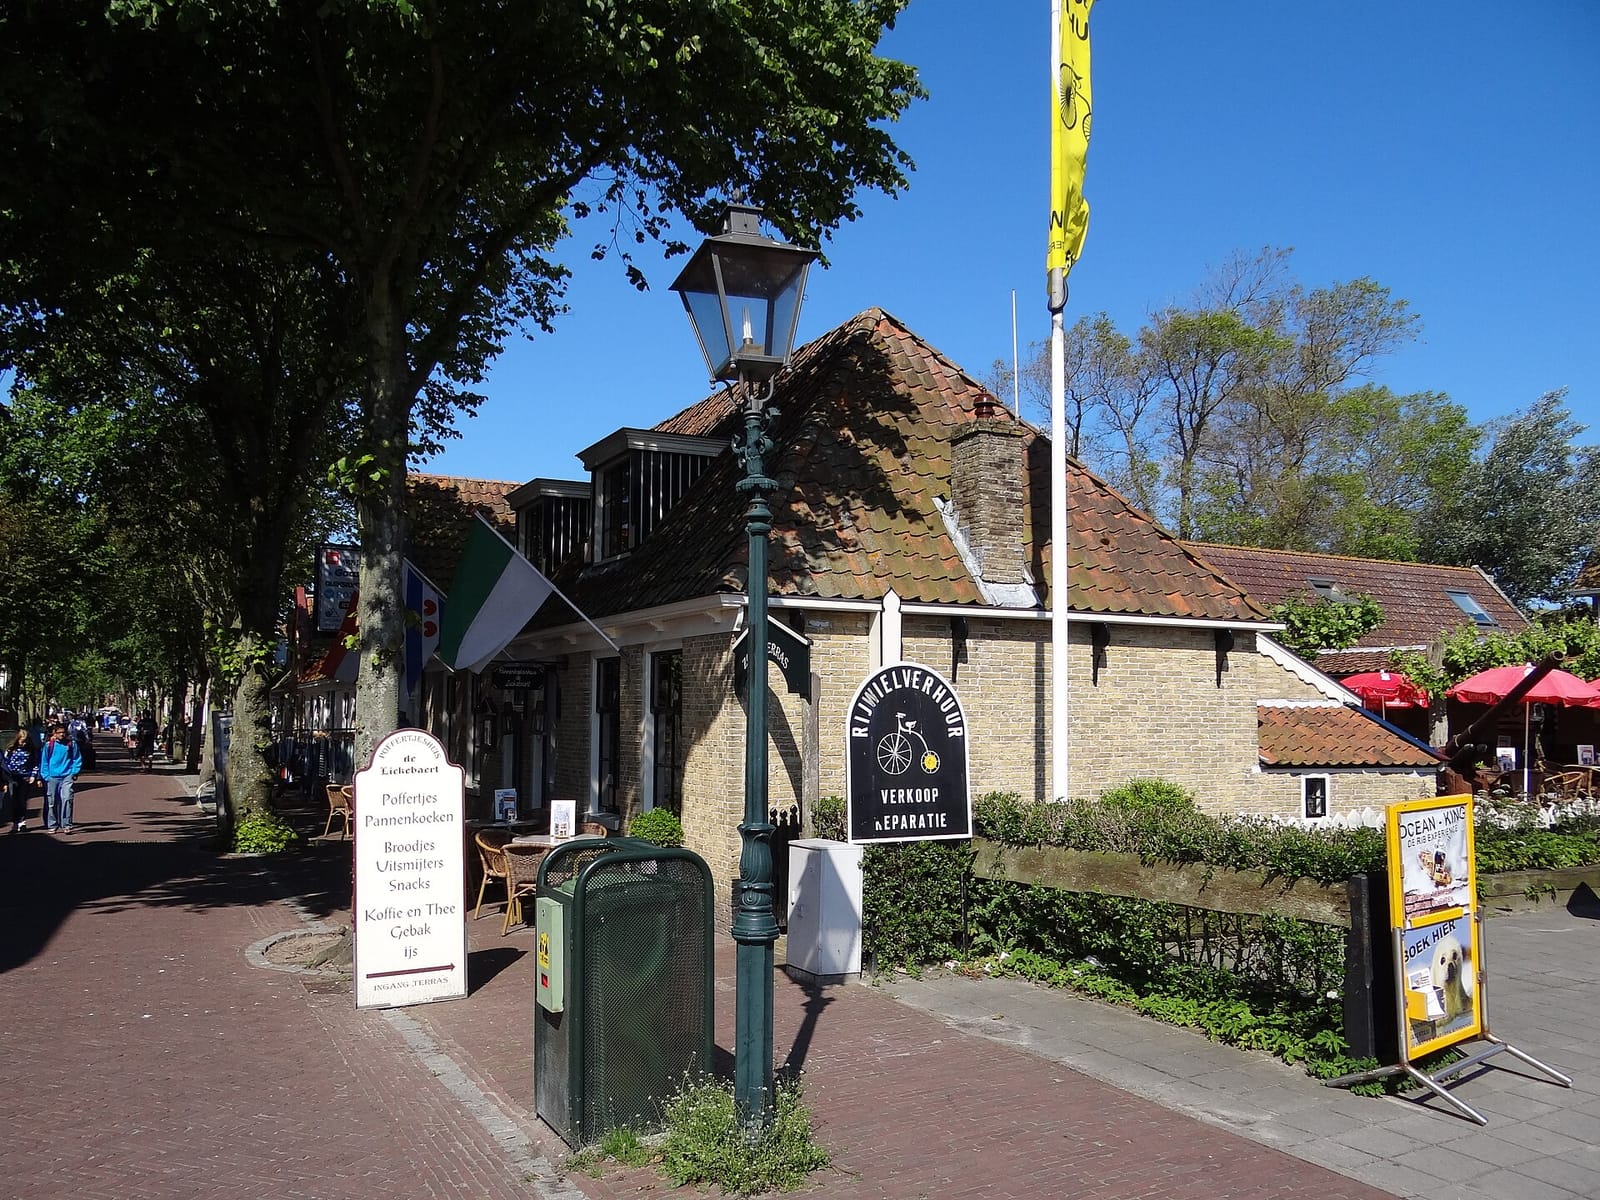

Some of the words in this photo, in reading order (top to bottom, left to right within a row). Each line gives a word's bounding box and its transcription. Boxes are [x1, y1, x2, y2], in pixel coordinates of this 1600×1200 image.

[852, 669, 964, 738] RIJWIELVERHUUR
[379, 735, 441, 759] POFFERTJESHUIS
[403, 755, 416, 763] de
[382, 792, 438, 806] Poffertjes
[880, 788, 939, 804] VERKOOP
[365, 811, 454, 828] Pannenkoeken
[1400, 816, 1436, 839] OCEAN
[1443, 806, 1466, 826] KING
[384, 839, 435, 854] Broodjes
[376, 858, 444, 872] Uitsmijters
[389, 877, 431, 892] Snacks
[365, 906, 403, 922] Koffie
[407, 908, 421, 918] en
[425, 903, 456, 915] Thee
[390, 922, 432, 940] Gebak
[1432, 920, 1457, 943] HIER
[373, 981, 409, 991] INGANG
[411, 976, 449, 987] TERRAS
